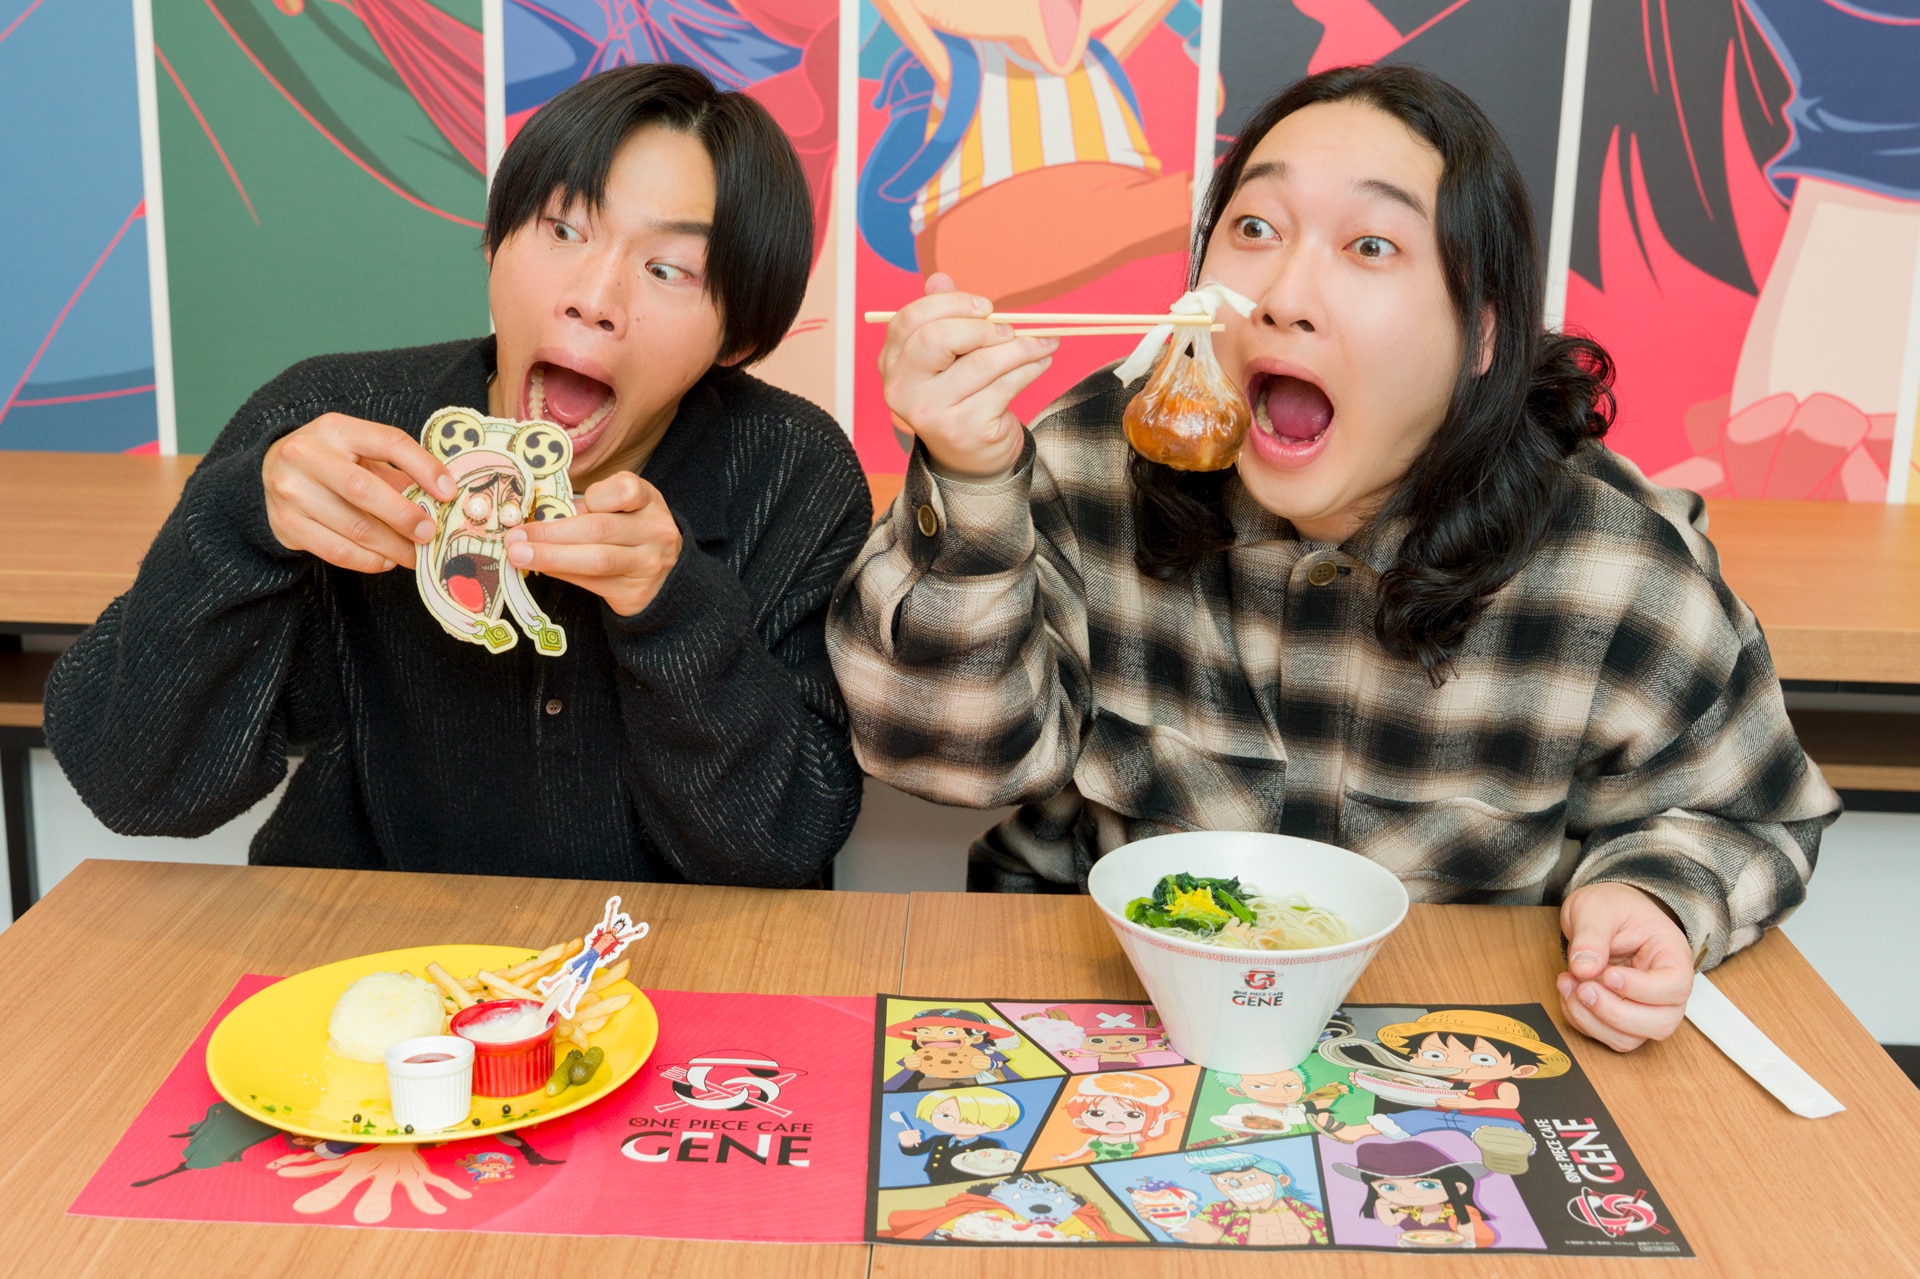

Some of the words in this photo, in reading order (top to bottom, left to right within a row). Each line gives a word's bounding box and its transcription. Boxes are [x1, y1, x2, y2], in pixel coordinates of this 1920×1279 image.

[1232, 995, 1283, 1006] GENE
[628, 1117, 680, 1128] ONE
[688, 1119, 748, 1131] PIECE
[757, 1121, 814, 1133] CAFE
[1533, 1118, 1557, 1139] CAFE
[620, 1131, 812, 1168] GENE
[1546, 1139, 1571, 1162] PIECE
[1552, 1117, 1625, 1184] GENE
[1558, 1162, 1582, 1184] ONE
